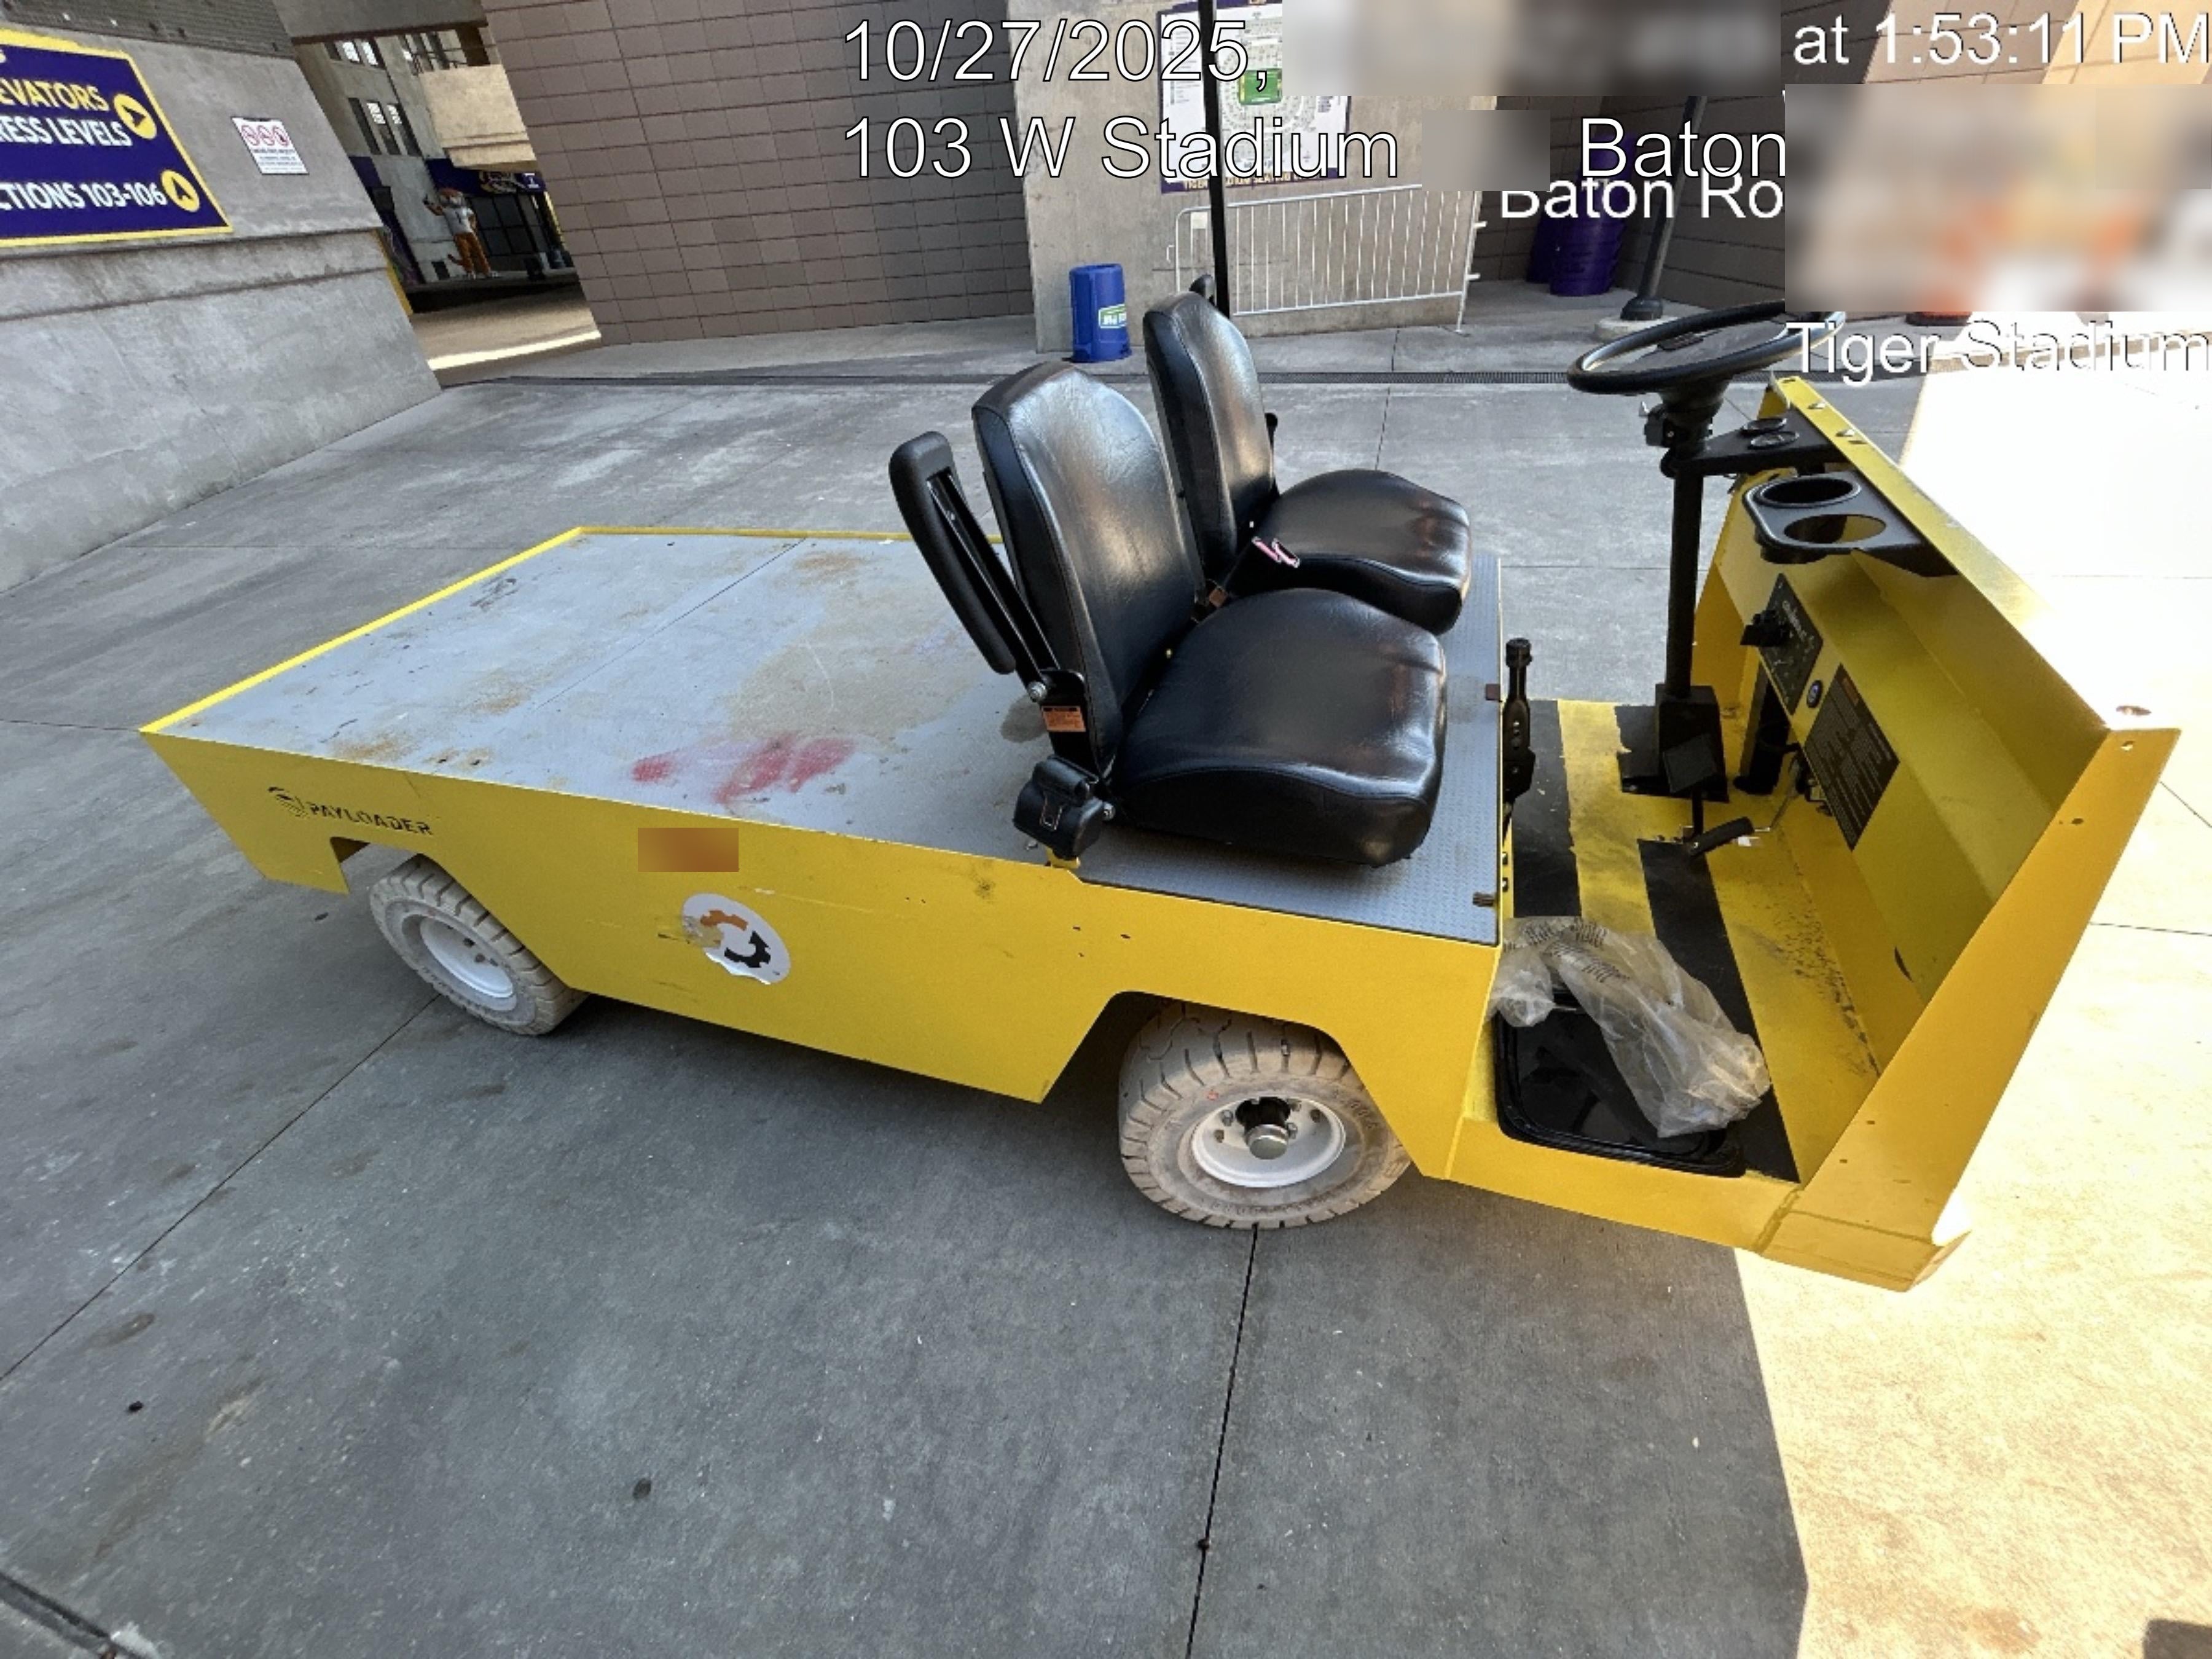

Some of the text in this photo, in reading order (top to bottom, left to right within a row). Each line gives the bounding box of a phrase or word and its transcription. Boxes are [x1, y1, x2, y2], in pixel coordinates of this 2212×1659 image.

[45, 117, 133, 146] LEVELS
[80, 182, 168, 208] 103-106
[307, 801, 434, 835] PAYLOADER
